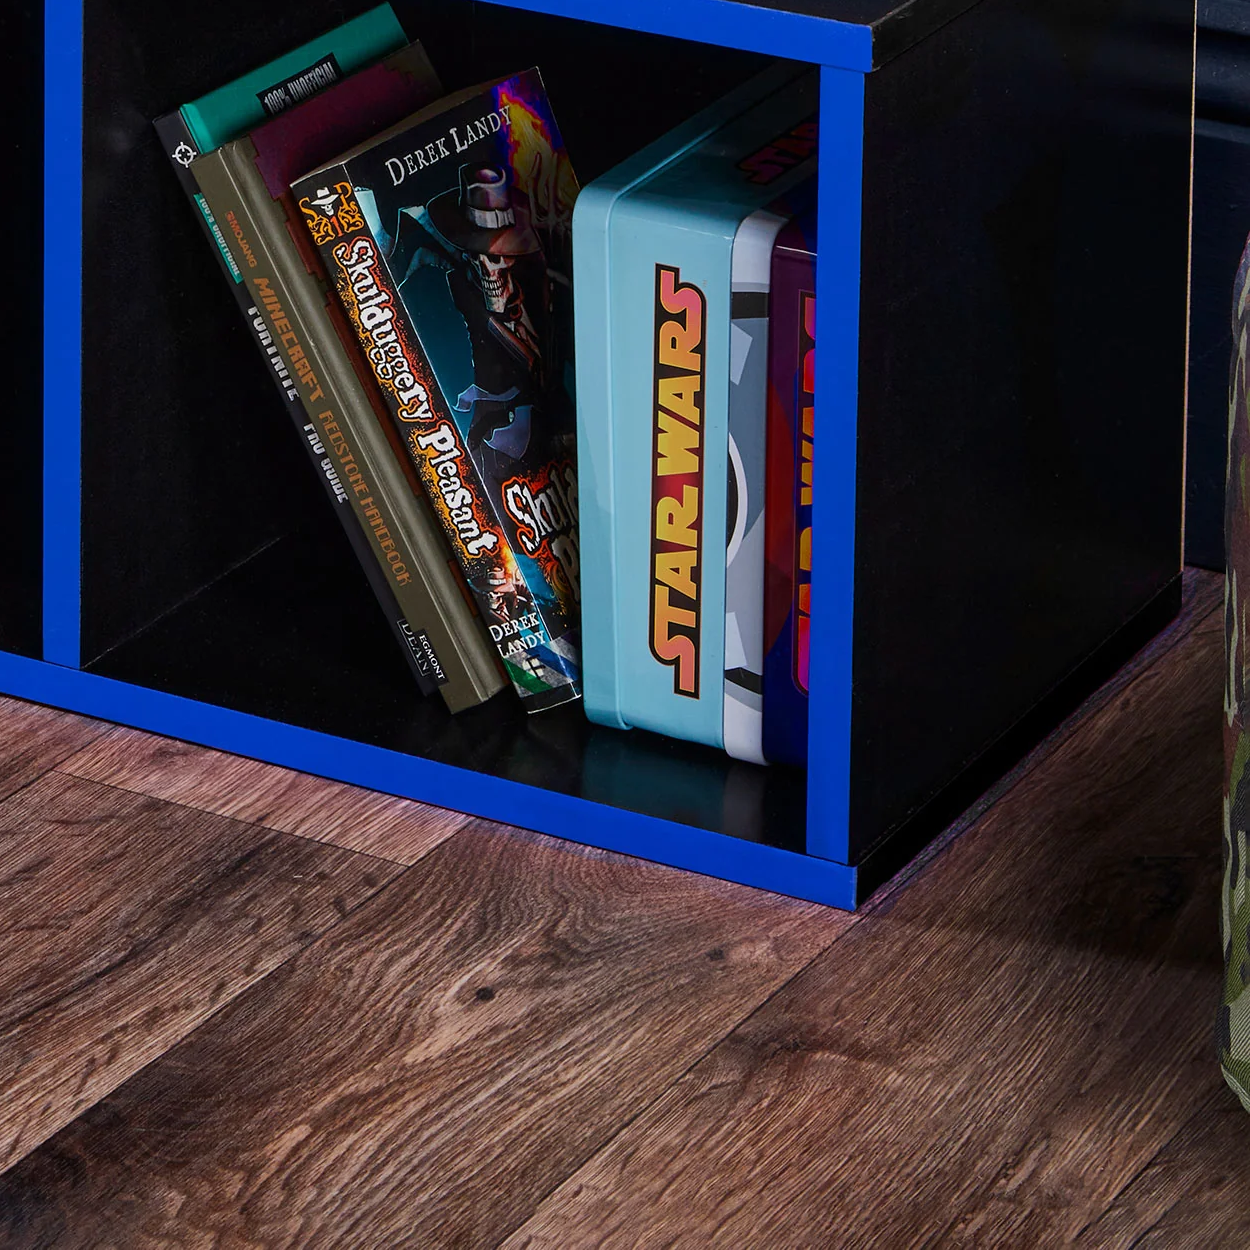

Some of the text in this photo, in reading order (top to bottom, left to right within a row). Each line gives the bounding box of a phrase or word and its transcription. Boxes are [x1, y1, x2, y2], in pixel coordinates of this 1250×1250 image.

[264, 61, 338, 115] 100% UNOFFICIAL
[385, 105, 512, 186] DEREK LANDY
[229, 219, 257, 268] MOJANG
[335, 240, 499, 556] Skulduggery Pleasant
[253, 277, 412, 587] MINECRAFT REDSTONE HANDBOOK
[653, 269, 702, 693] STAR WARS
[402, 623, 429, 671] DEAN
[489, 612, 540, 642] DEREK
[497, 630, 546, 658] LANDY
[419, 634, 445, 679] EGMONT
